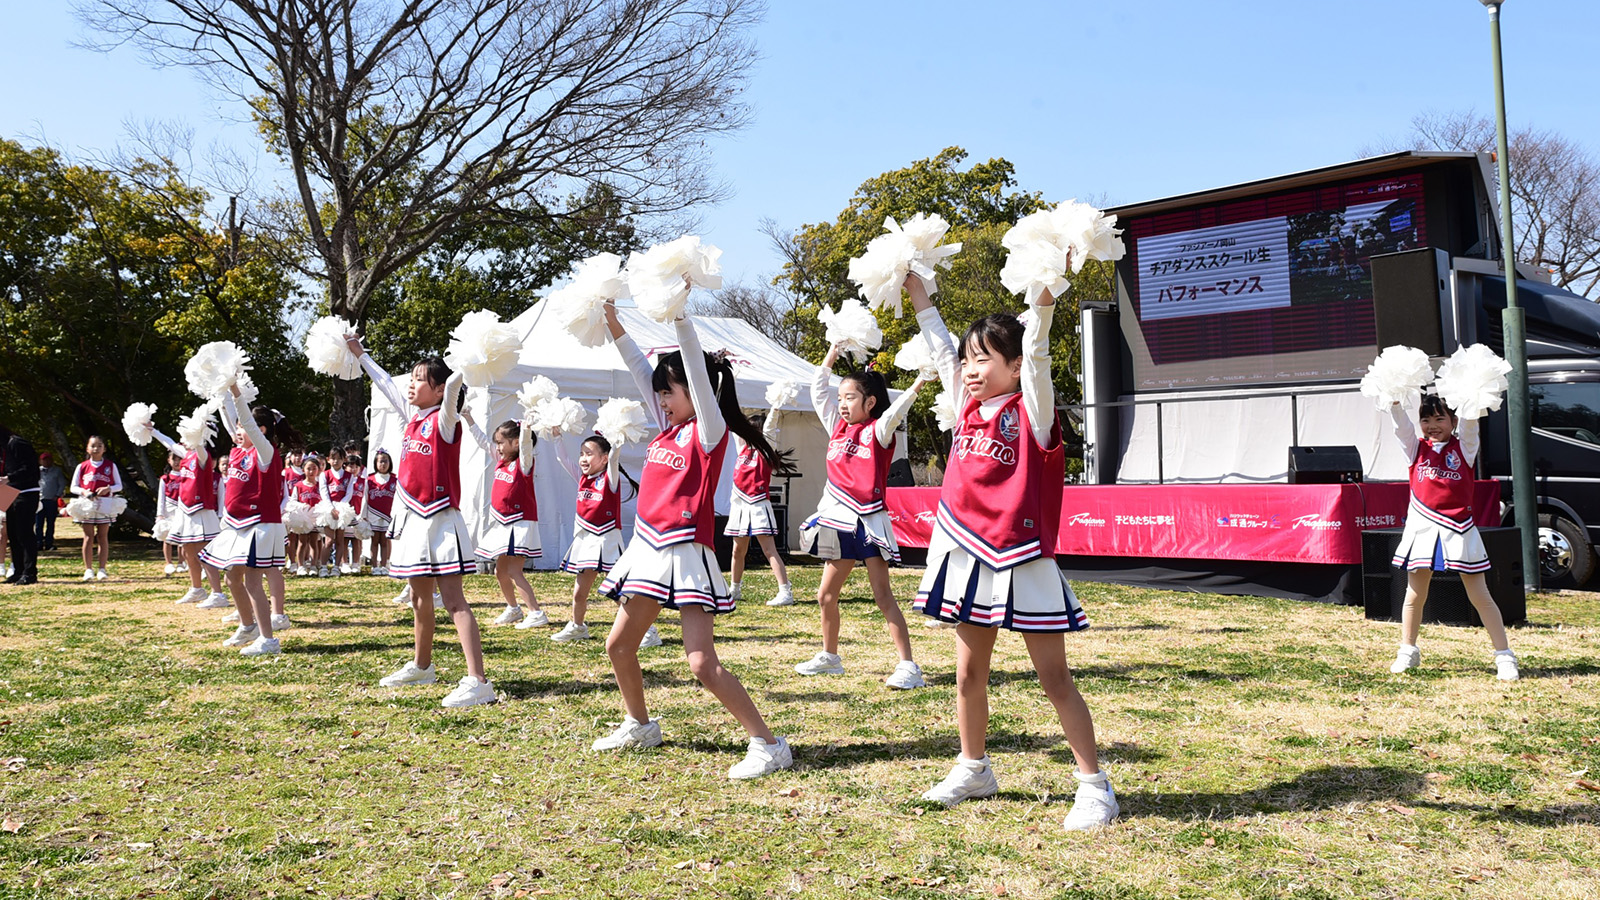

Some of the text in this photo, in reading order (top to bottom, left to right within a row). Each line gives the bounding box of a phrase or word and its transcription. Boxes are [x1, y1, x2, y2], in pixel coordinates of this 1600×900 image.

[1150, 246, 1271, 276] チアダンススクール生
[1158, 275, 1264, 303] パフォーマンス
[1417, 459, 1462, 483] Fagiano
[1068, 512, 1106, 527] Fagiano
[1291, 513, 1342, 530] Fagiano
